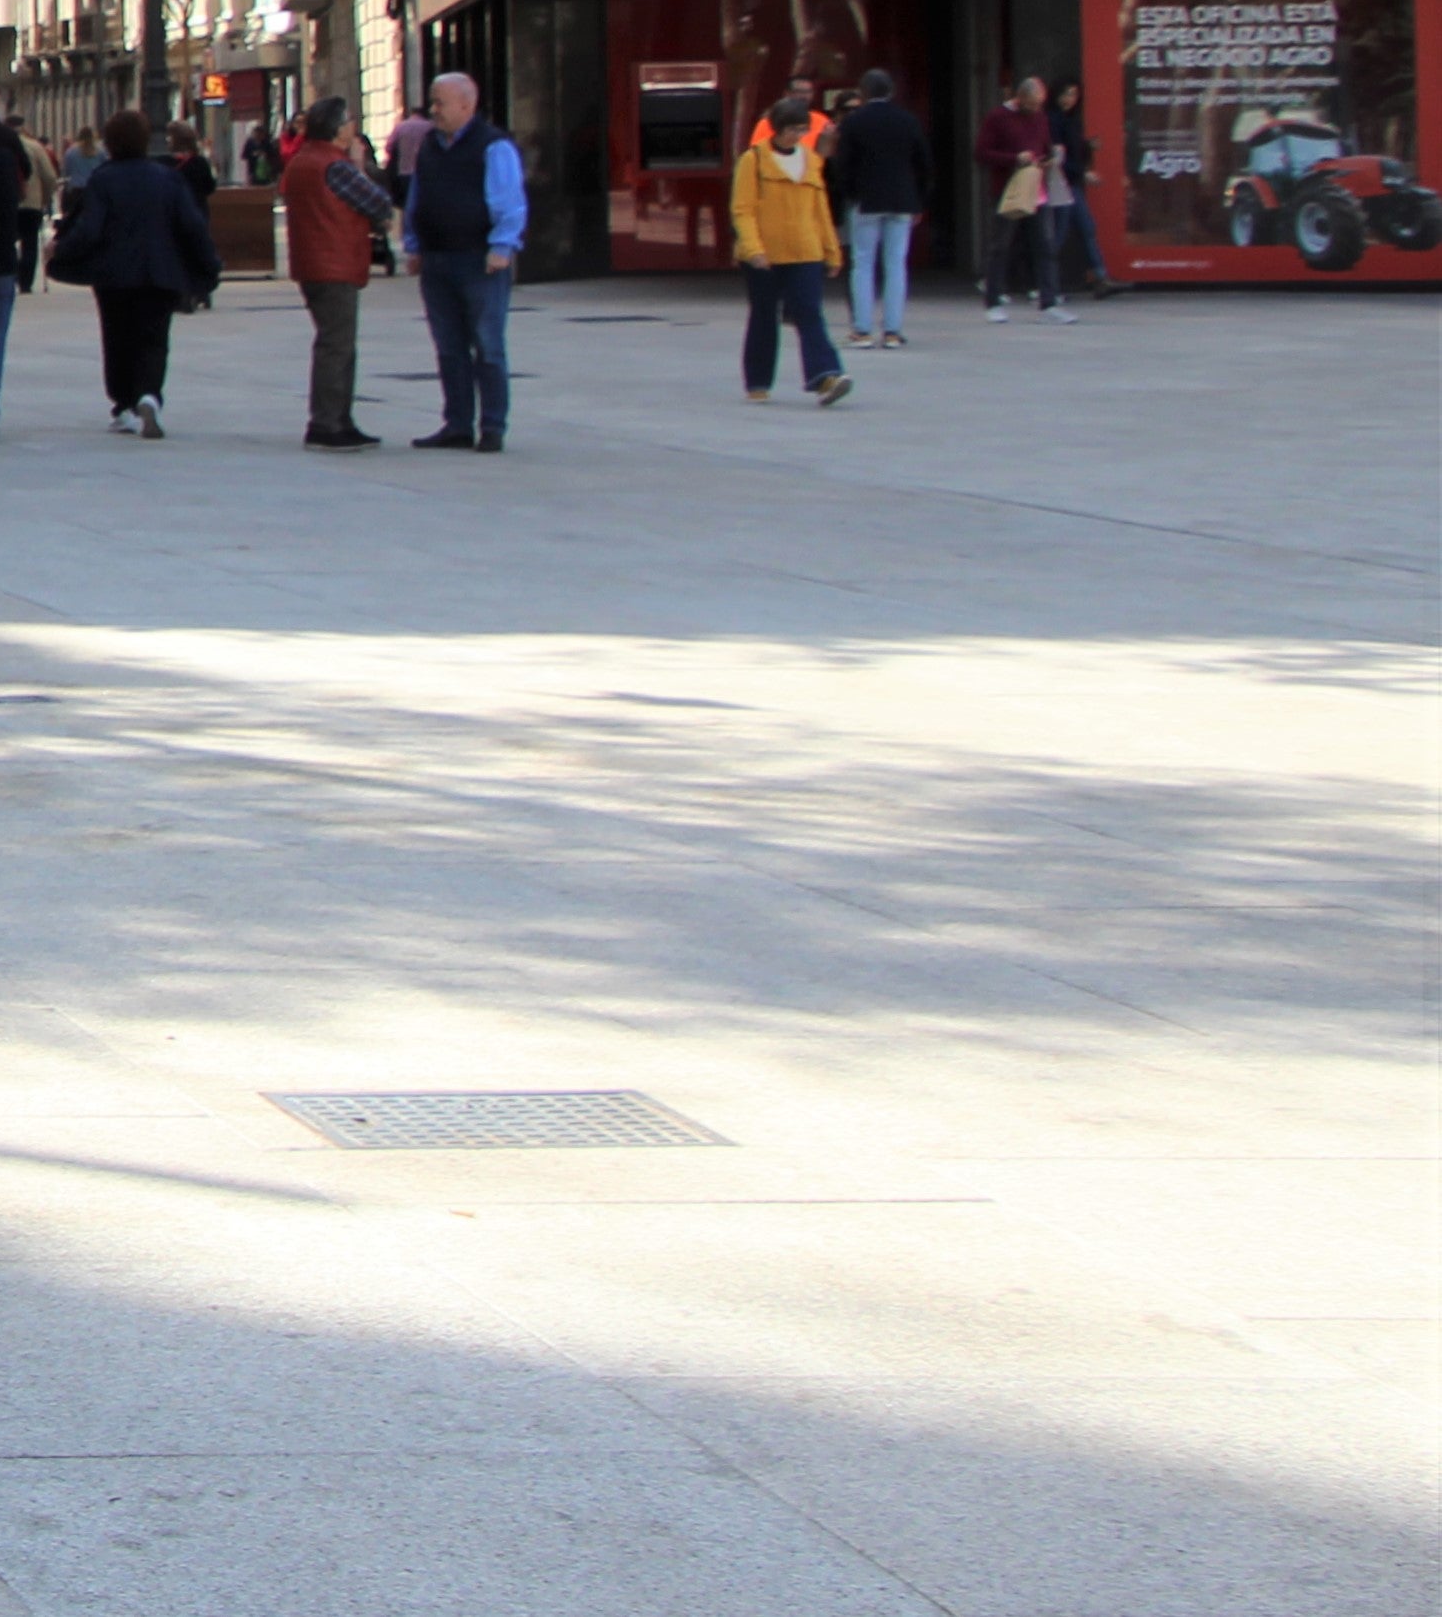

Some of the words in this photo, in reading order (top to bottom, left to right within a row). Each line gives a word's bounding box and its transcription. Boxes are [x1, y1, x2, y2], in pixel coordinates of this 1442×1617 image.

[1136, 6, 1189, 25] ESTA
[1191, 5, 1281, 24] OFICINA
[1283, 0, 1339, 22] ESTÁ
[1136, 26, 1301, 47] ESPECIALIZADA
[1304, 25, 1337, 43] EN
[1137, 49, 1163, 68] EL
[1166, 47, 1267, 67] NEGOCIO
[1269, 46, 1333, 66] AGRO
[1138, 149, 1202, 179] Agro
